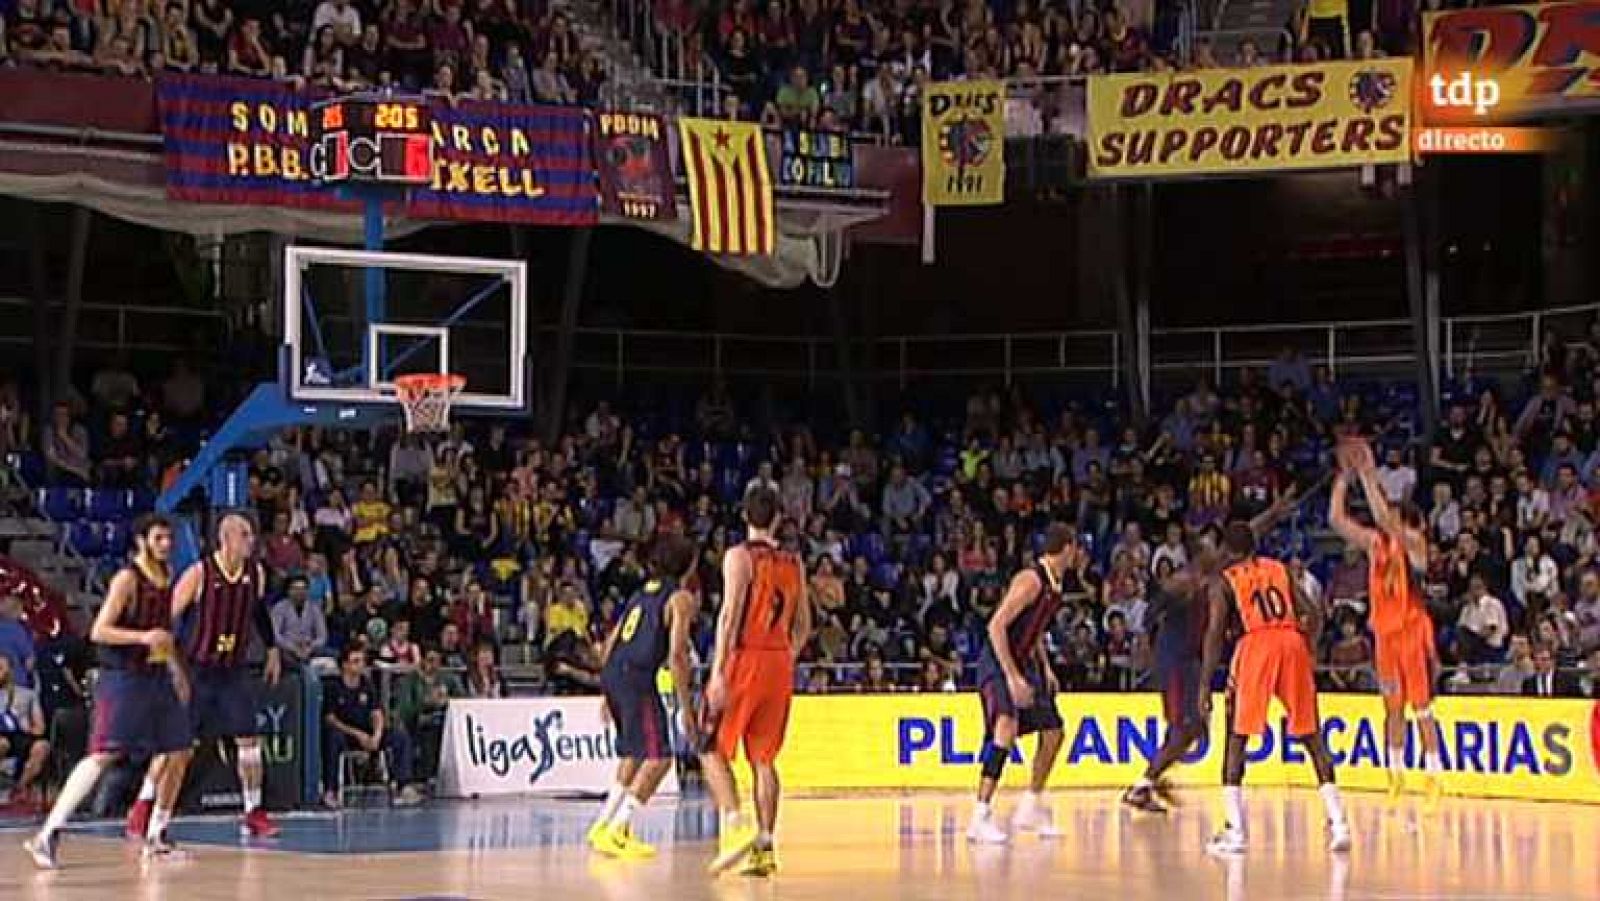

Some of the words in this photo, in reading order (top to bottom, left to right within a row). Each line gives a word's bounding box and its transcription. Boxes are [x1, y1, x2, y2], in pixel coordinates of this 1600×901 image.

[1121, 73, 1324, 118] DRACS
[232, 102, 309, 137] SOM
[1097, 115, 1404, 166] SUPPORTERS
[1252, 586, 1287, 622] 10
[466, 713, 537, 777] liga
[556, 727, 613, 760] end
